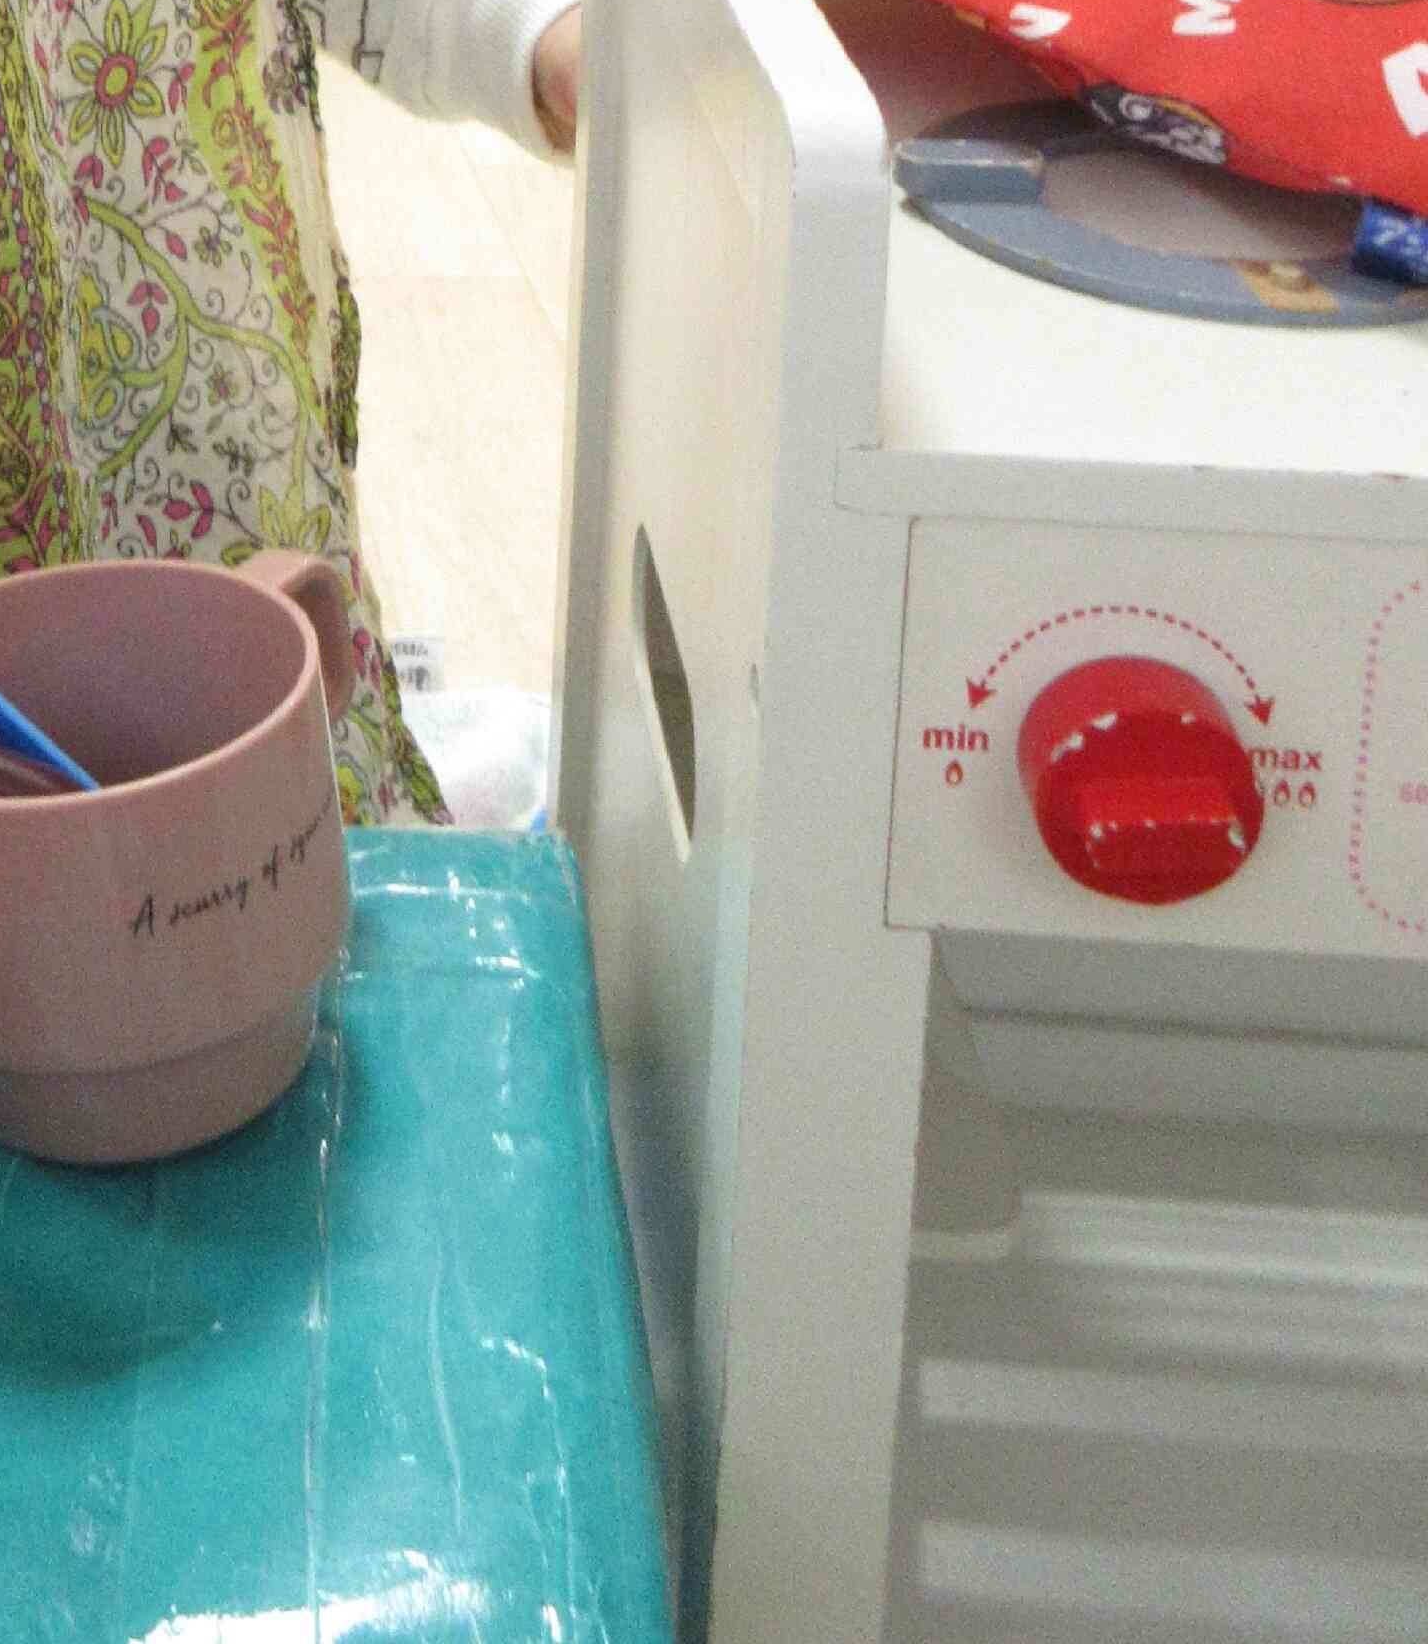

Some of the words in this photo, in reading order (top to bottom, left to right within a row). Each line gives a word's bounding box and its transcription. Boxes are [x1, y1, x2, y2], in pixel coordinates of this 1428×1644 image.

[923, 723, 989, 752] min
[1250, 747, 1323, 772] max
[131, 890, 155, 938] A
